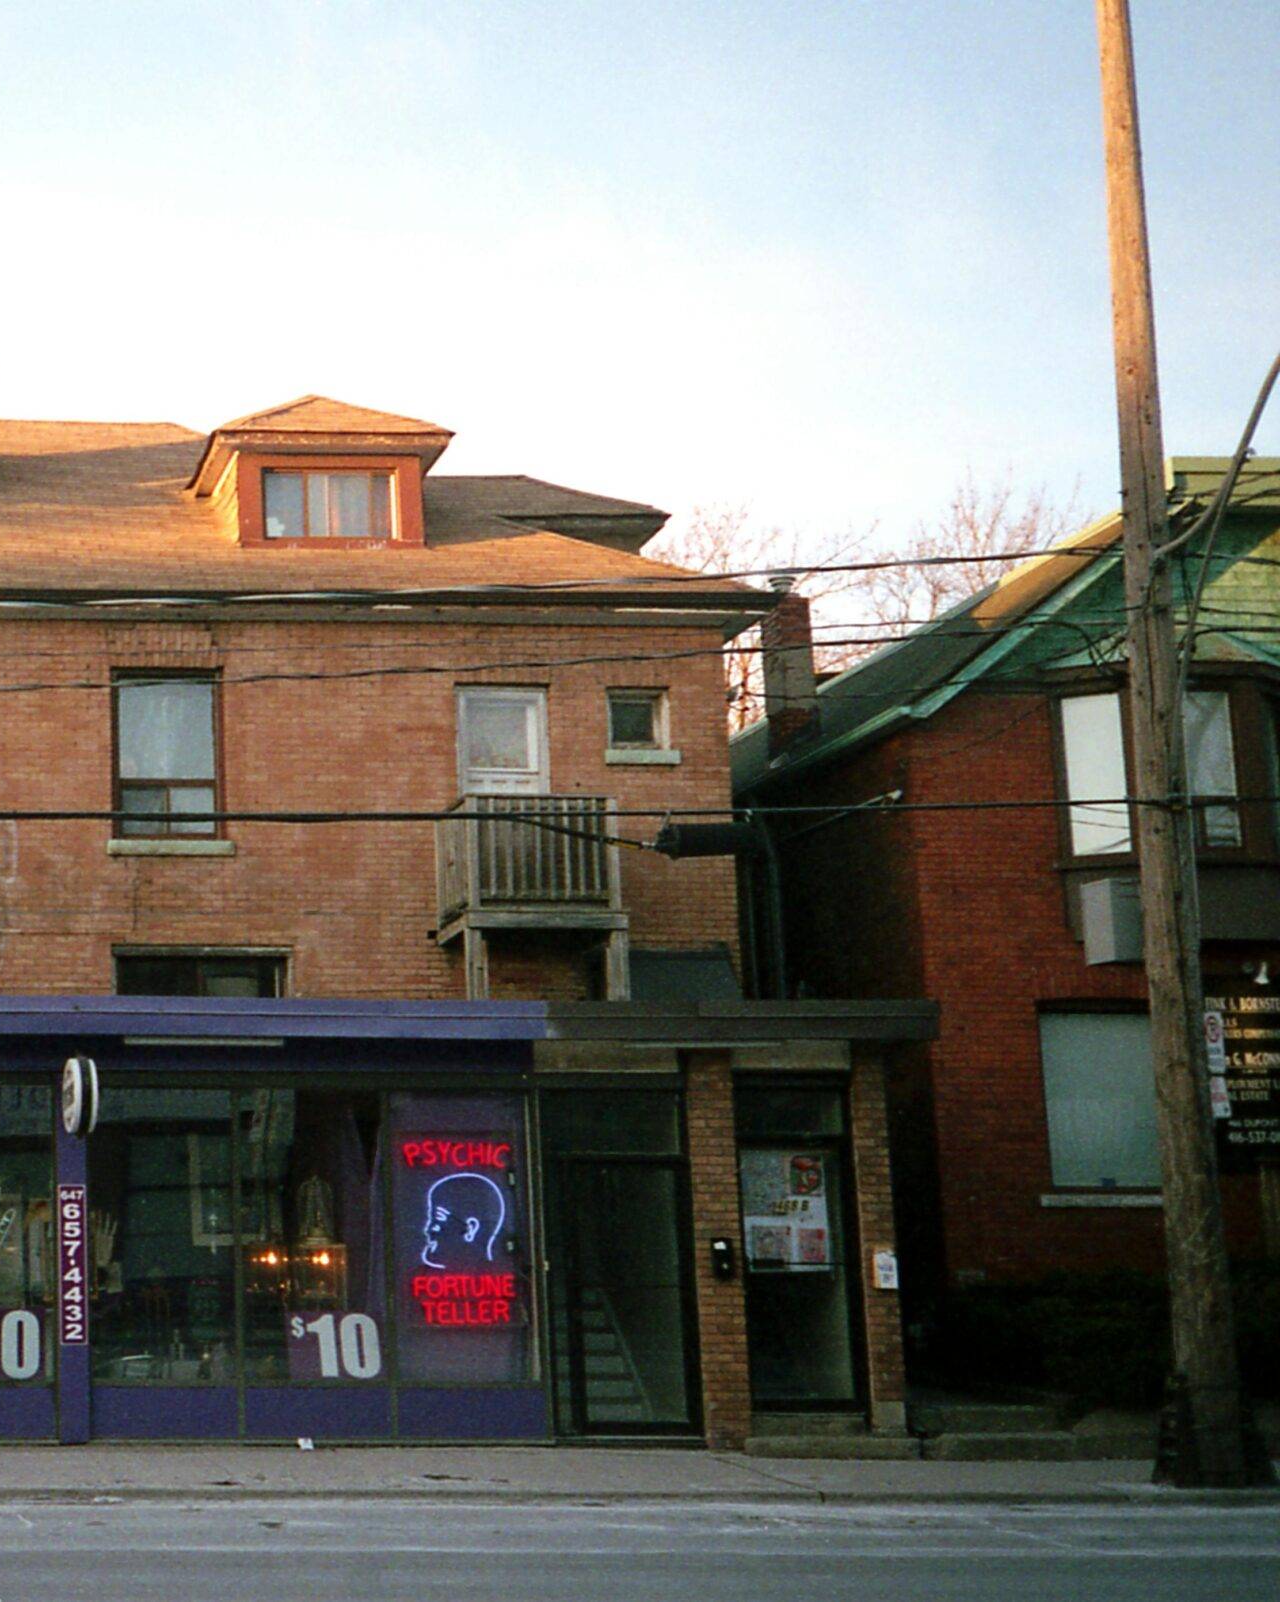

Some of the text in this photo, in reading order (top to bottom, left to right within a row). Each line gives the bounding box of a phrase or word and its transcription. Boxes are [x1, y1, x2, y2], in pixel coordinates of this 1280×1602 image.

[403, 1139, 509, 1169] PSYCHIC
[412, 1274, 515, 1298] FORTUNE
[421, 1300, 509, 1324] TELLER
